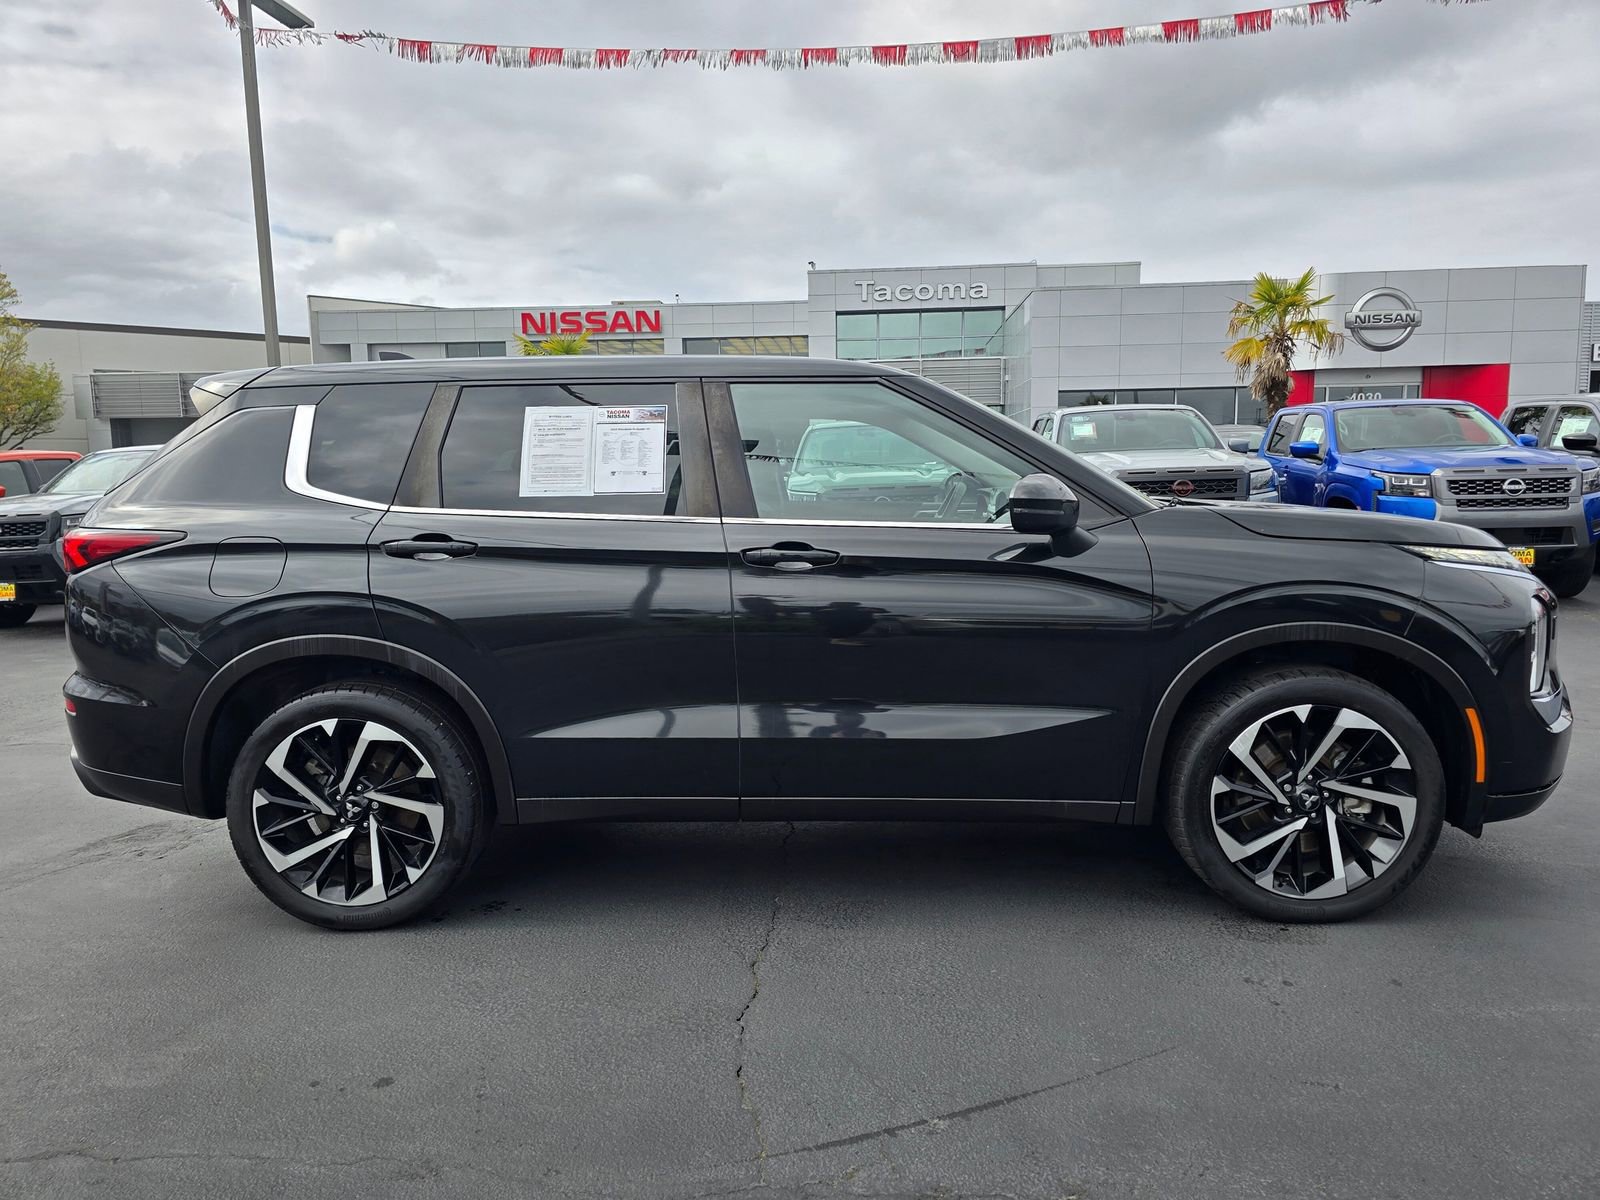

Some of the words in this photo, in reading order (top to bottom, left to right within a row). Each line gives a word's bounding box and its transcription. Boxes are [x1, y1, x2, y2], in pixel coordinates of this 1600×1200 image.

[855, 280, 988, 302] Tacoma
[521, 310, 660, 334] NISSAN
[1354, 313, 1416, 324] NISSAN
